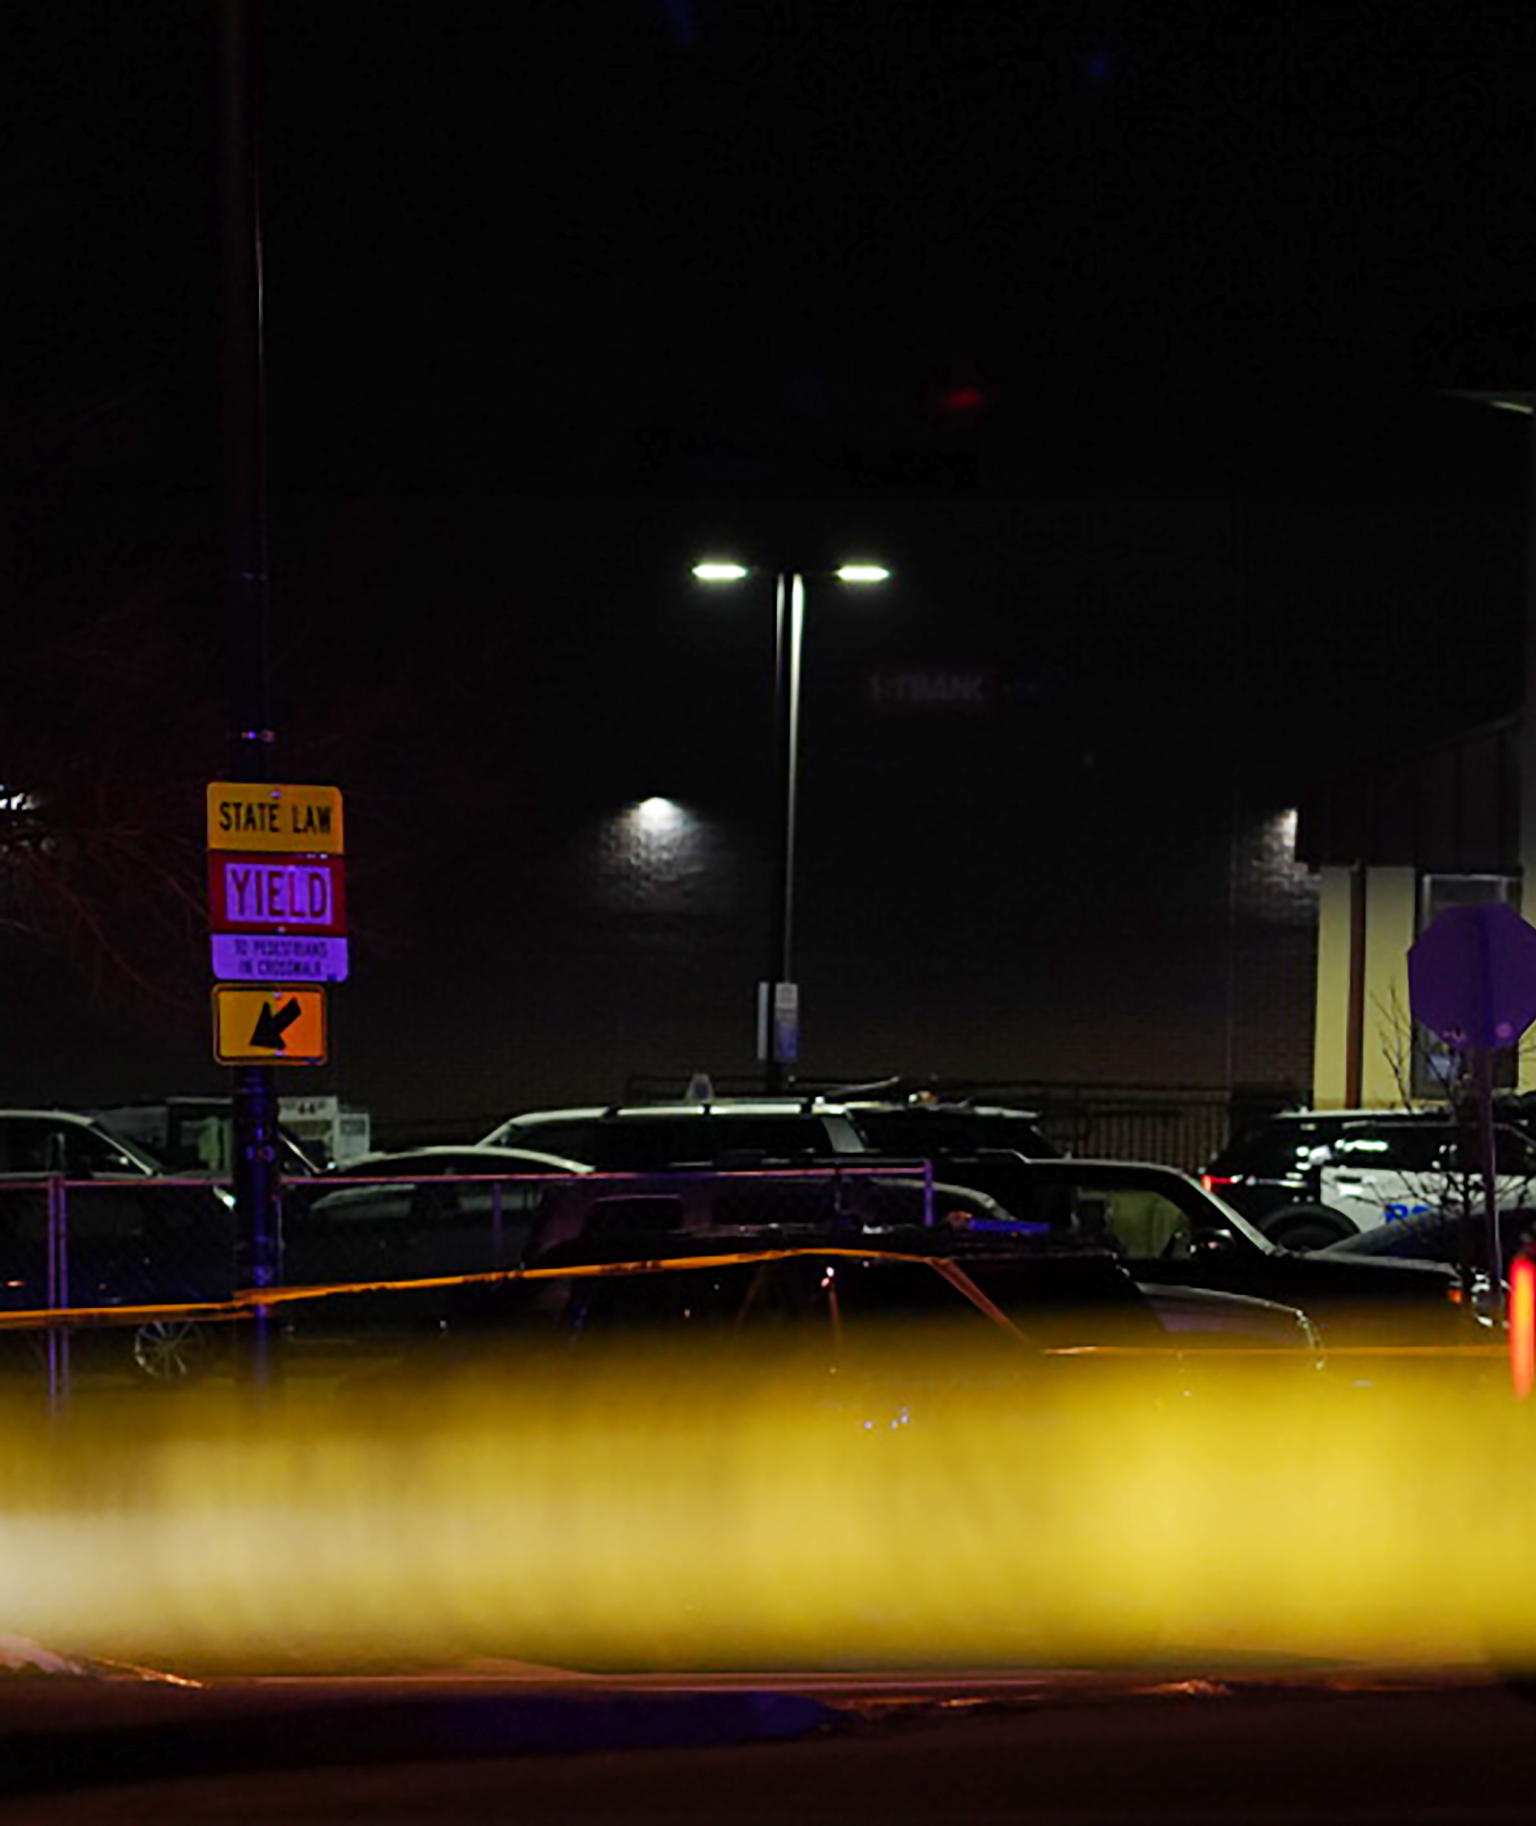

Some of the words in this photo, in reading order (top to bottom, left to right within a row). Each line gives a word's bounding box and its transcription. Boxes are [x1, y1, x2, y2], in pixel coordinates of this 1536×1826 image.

[219, 802, 280, 832] STATE
[293, 805, 332, 834] LAW
[231, 869, 327, 918] YIELD
